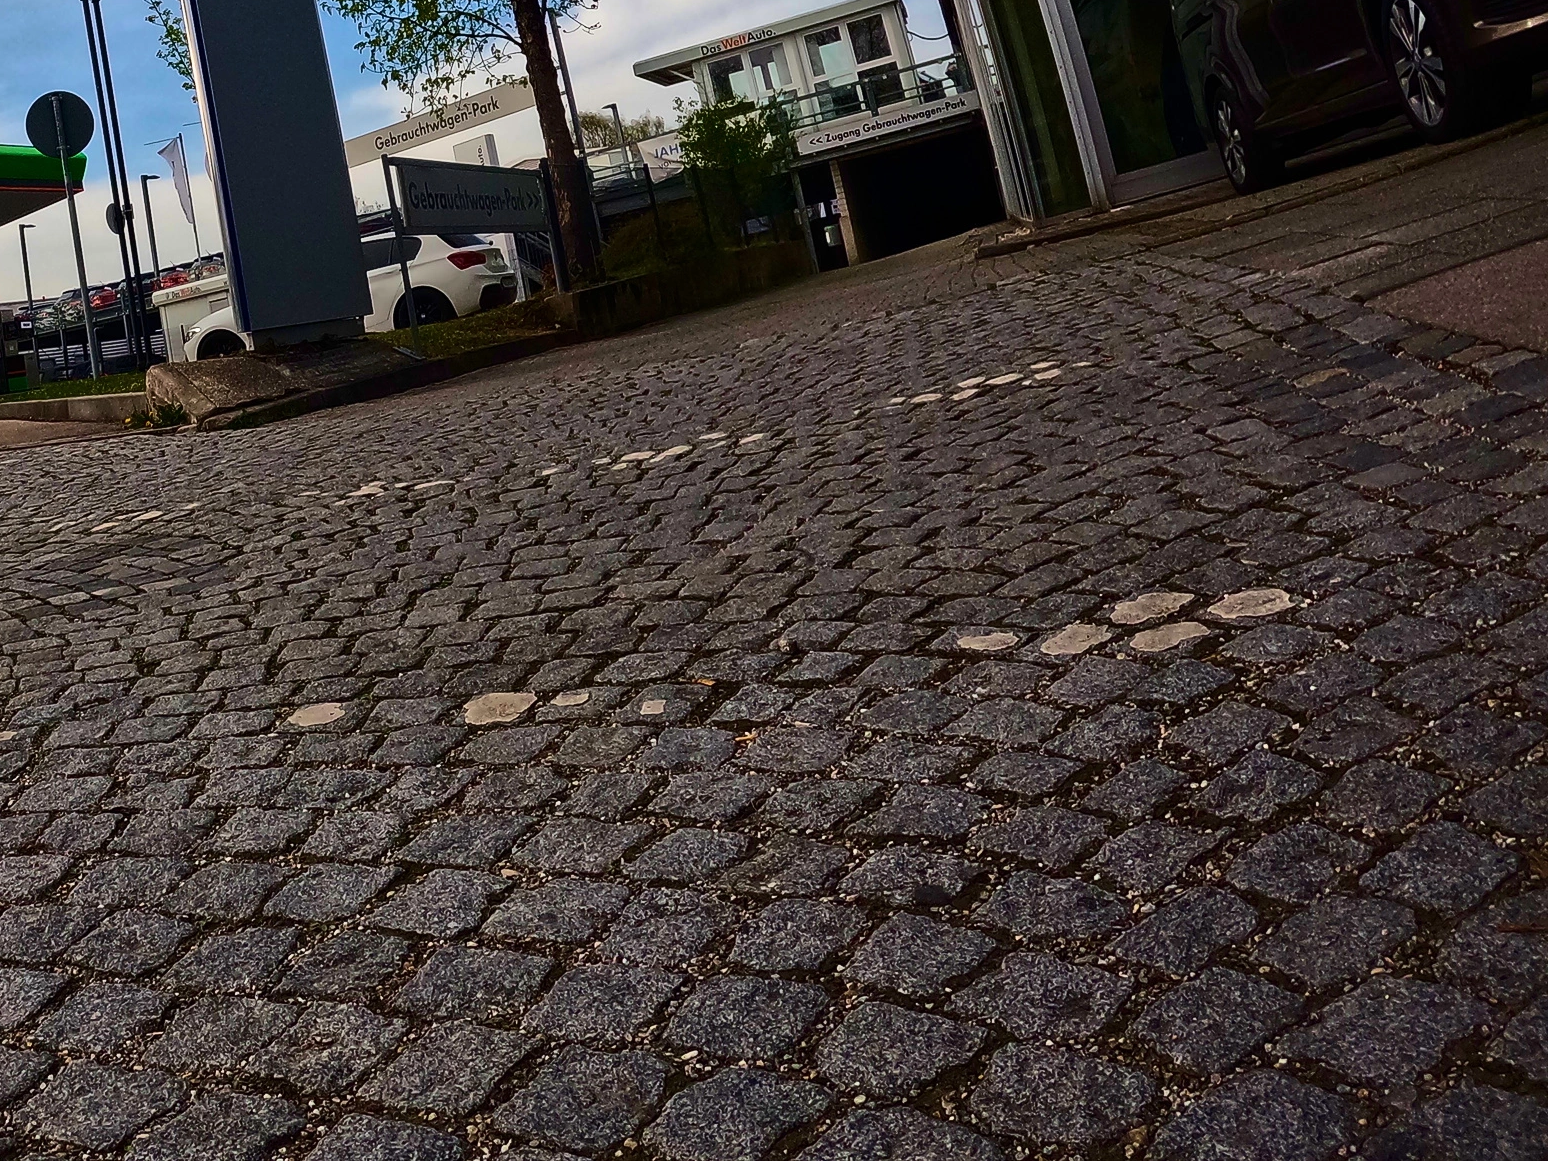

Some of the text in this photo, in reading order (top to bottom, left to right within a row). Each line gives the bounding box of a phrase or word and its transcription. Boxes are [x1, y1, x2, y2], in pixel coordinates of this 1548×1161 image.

[700, 29, 777, 56] DasWeltAuto.
[374, 96, 500, 150] Gebrauchtwagen-Park
[825, 97, 968, 144] Zugang Gebrauchtwagen-Park
[654, 143, 684, 159] JAH
[409, 181, 527, 217] Gebrauchtwagen-Park
